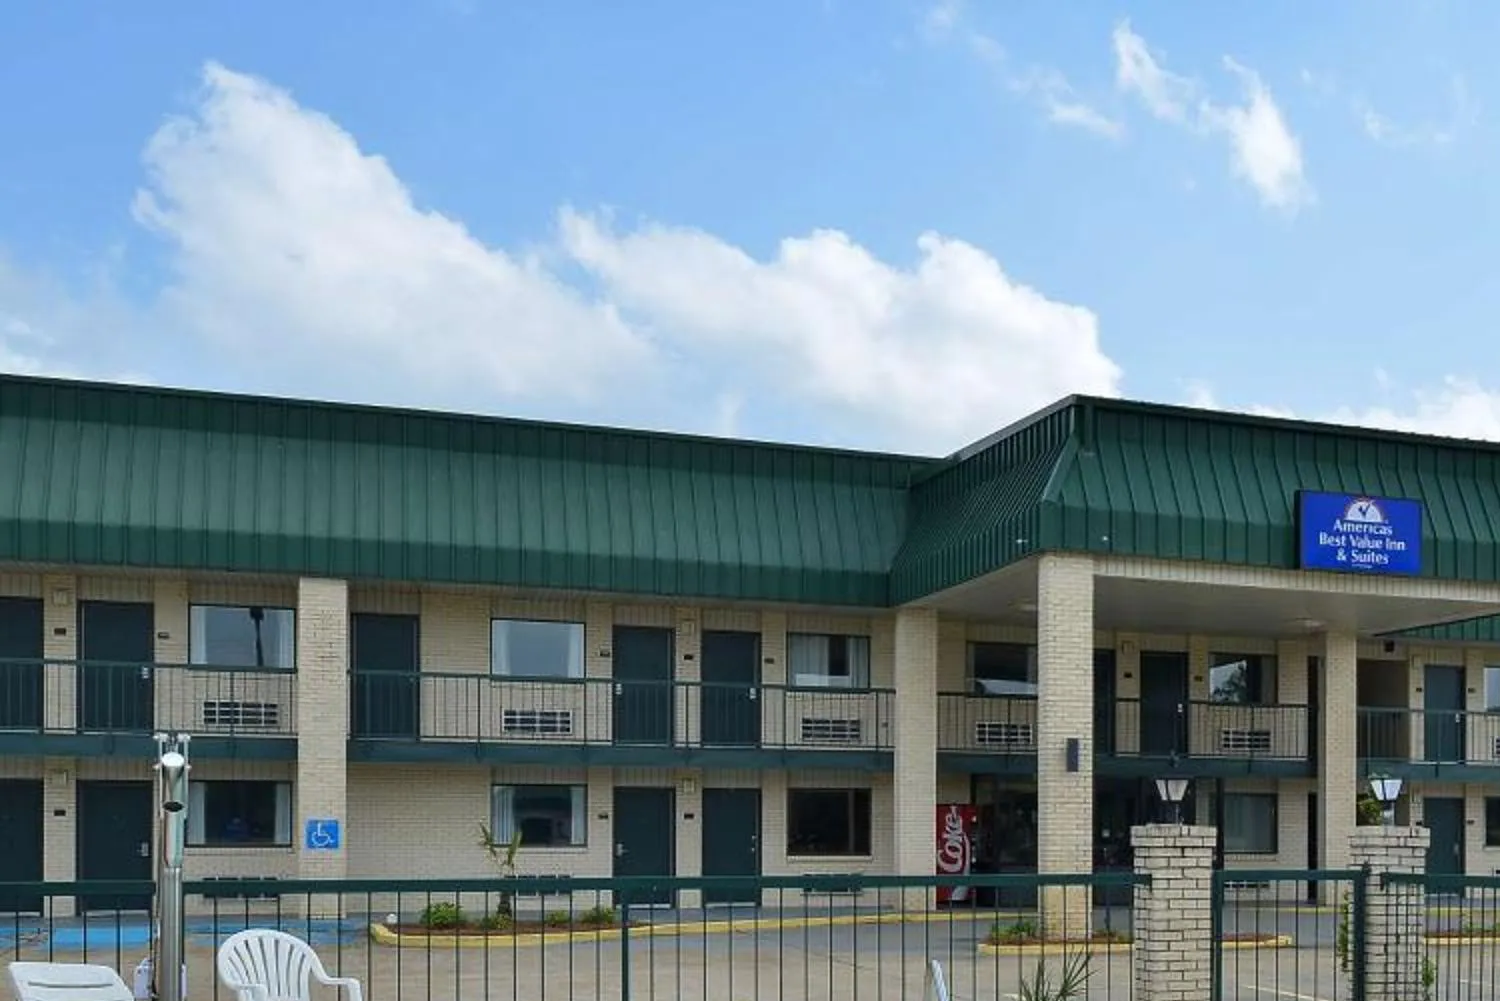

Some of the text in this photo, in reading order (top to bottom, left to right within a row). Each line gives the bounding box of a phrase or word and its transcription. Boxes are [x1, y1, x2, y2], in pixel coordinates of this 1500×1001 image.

[1334, 519, 1393, 535] Americas
[1319, 532, 1406, 551] Best Value Inn
[1336, 548, 1389, 565] & Suites
[938, 806, 963, 872] Coke
